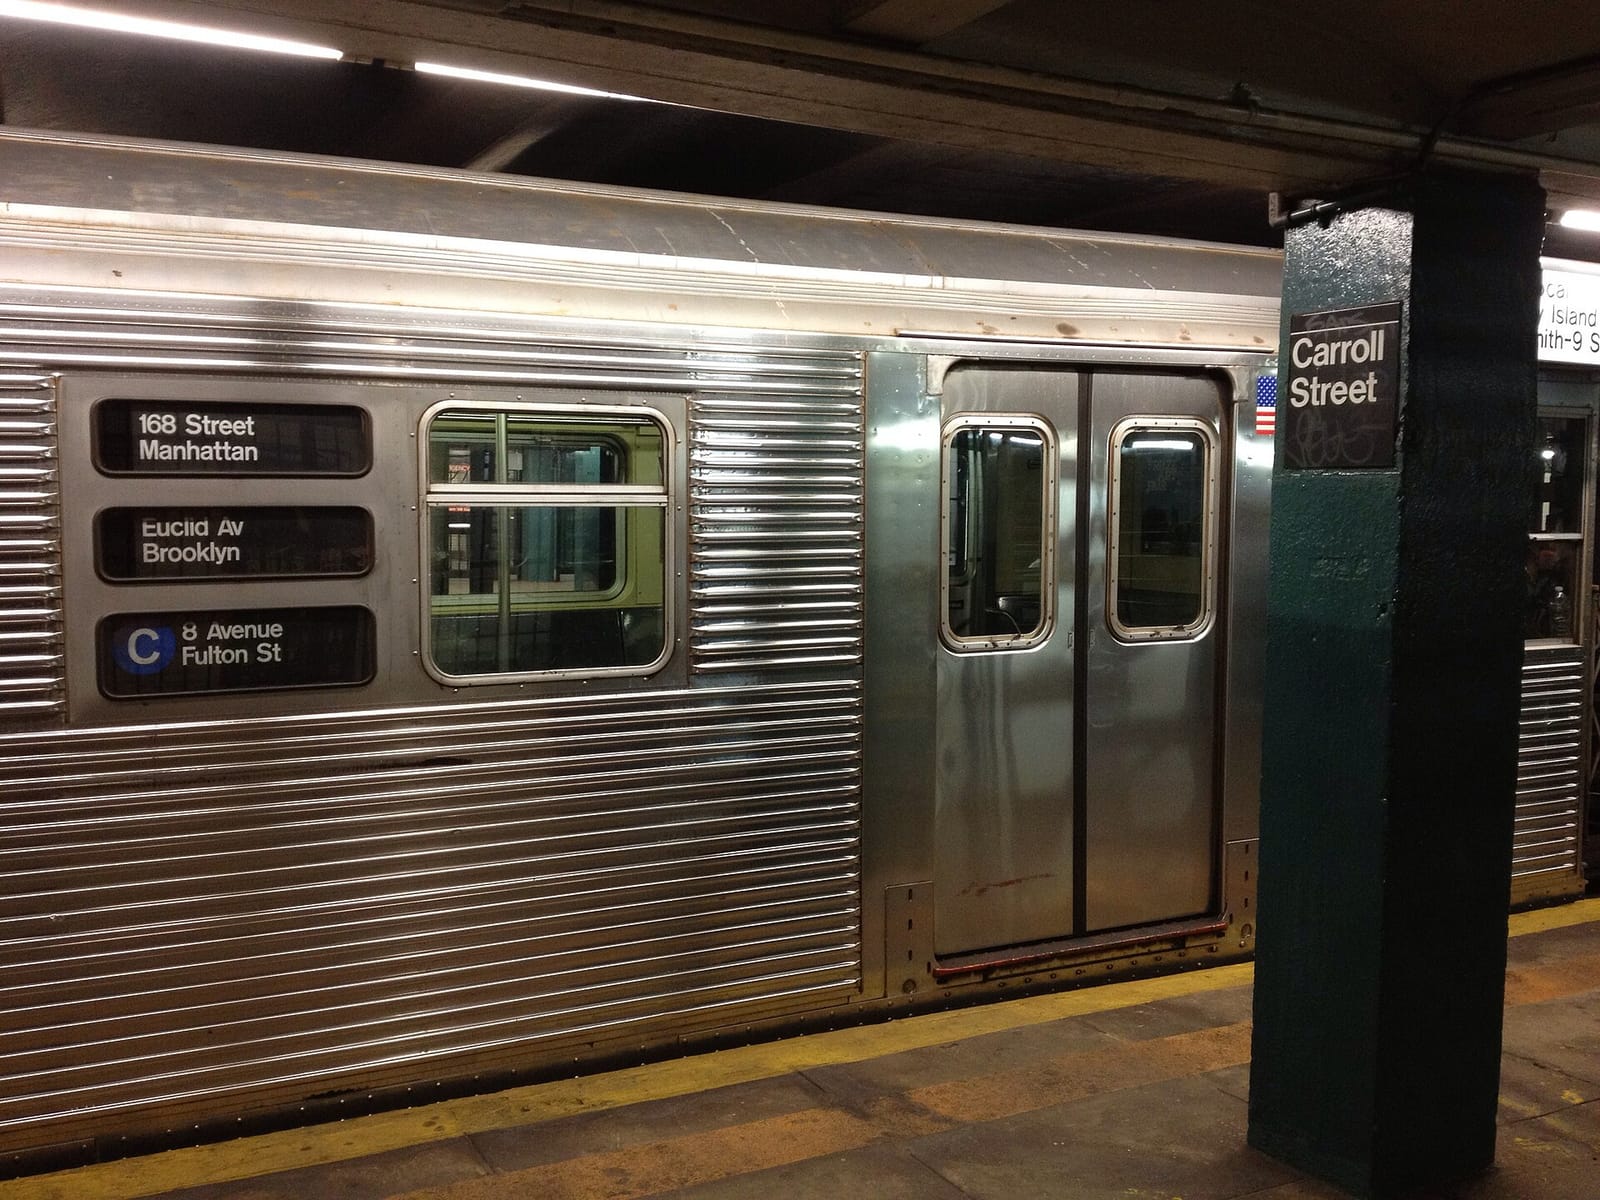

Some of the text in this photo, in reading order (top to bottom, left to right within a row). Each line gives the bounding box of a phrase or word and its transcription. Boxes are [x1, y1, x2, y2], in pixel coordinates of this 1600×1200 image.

[1552, 304, 1597, 327] Island
[1292, 329, 1385, 369] Carroll
[1538, 329, 1582, 351] ith-9
[1290, 371, 1378, 408] Street
[138, 413, 255, 436] 168 Street
[139, 440, 258, 461] Manhattan
[142, 516, 244, 537] Euclid Av
[143, 542, 240, 565] Brooklyn
[182, 621, 283, 640] 8 Avenue
[127, 628, 160, 665] C
[182, 643, 282, 666] Fulton St
